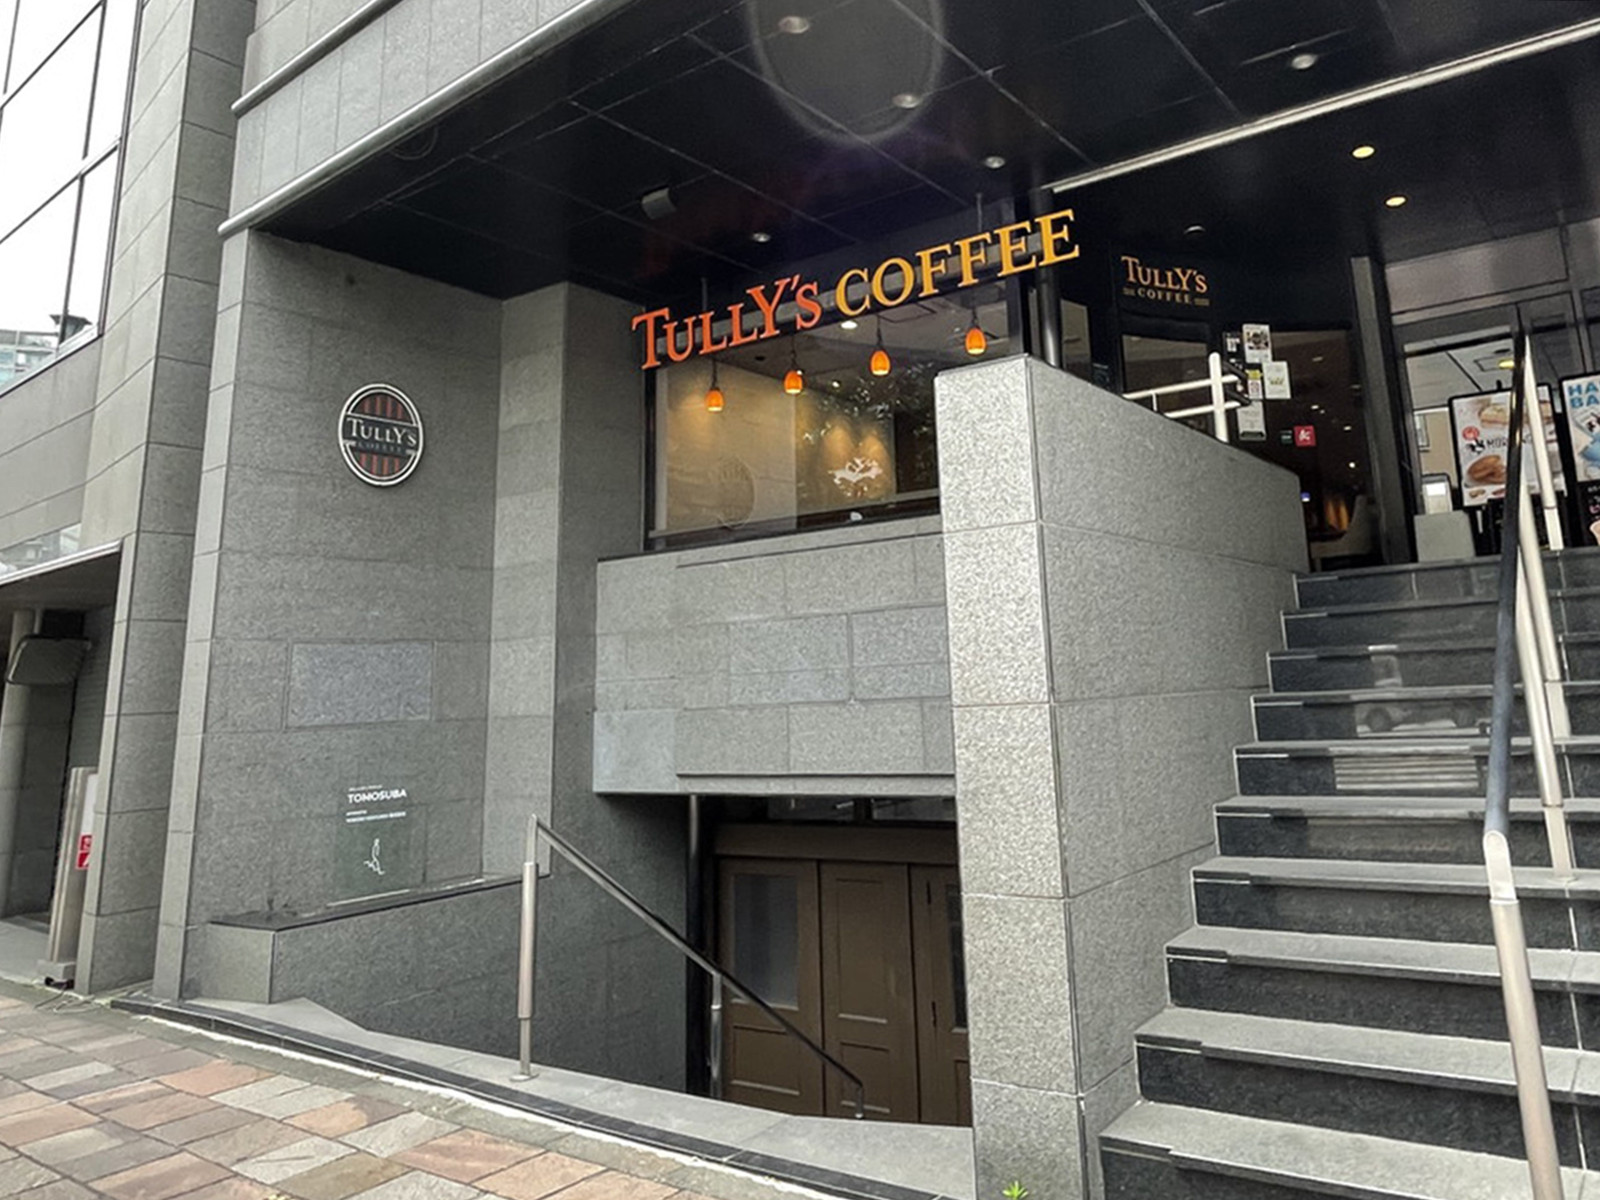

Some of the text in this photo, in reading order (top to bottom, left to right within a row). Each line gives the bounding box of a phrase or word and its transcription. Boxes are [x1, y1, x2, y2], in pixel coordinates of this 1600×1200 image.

[1121, 256, 1208, 293] TULLY'S
[632, 208, 1081, 369] TULLY'S COFFEE
[1137, 287, 1191, 304] COFFEE
[347, 788, 407, 804] TOMOSUBA
